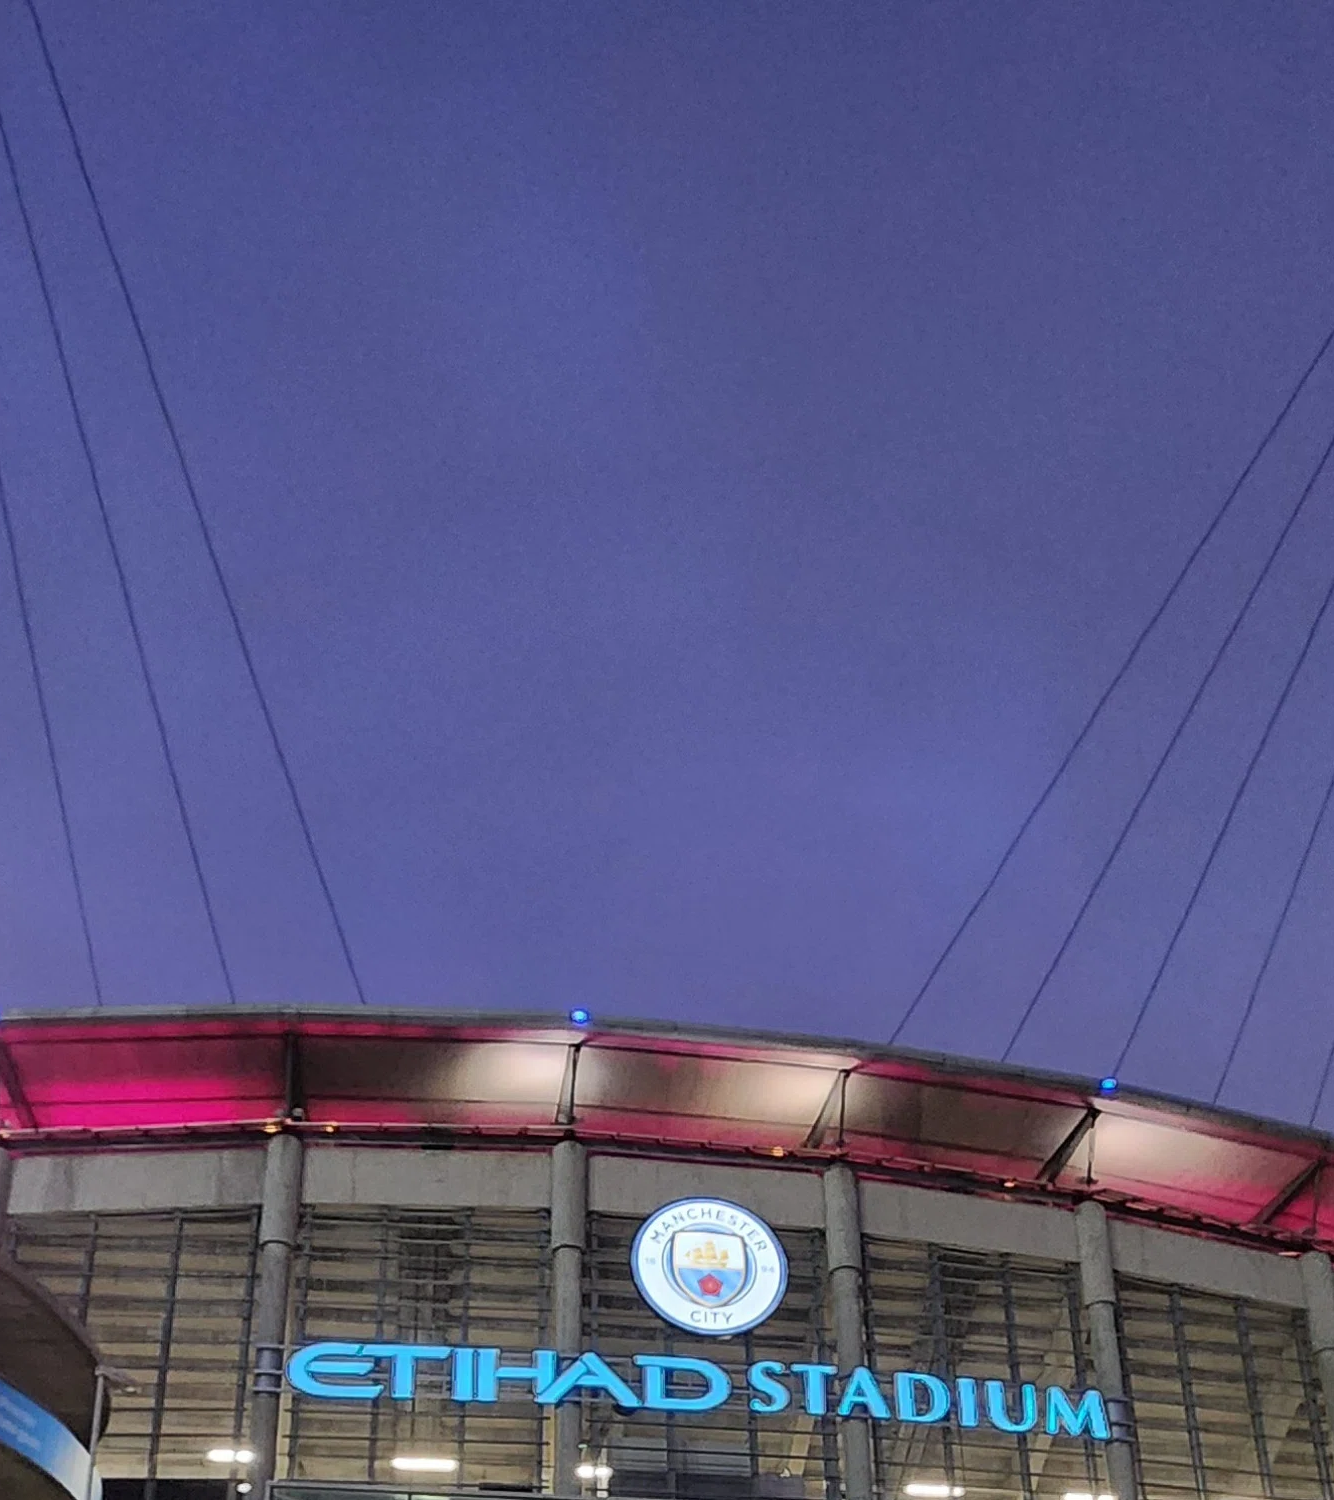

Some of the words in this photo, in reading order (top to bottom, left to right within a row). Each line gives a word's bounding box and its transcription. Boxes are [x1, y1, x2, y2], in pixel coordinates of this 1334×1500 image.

[649, 1208, 767, 1252] MANCHESTER
[690, 1311, 733, 1325] CITY
[286, 1342, 733, 1411] ETIHAD
[746, 1360, 1112, 1441] STADIUM
